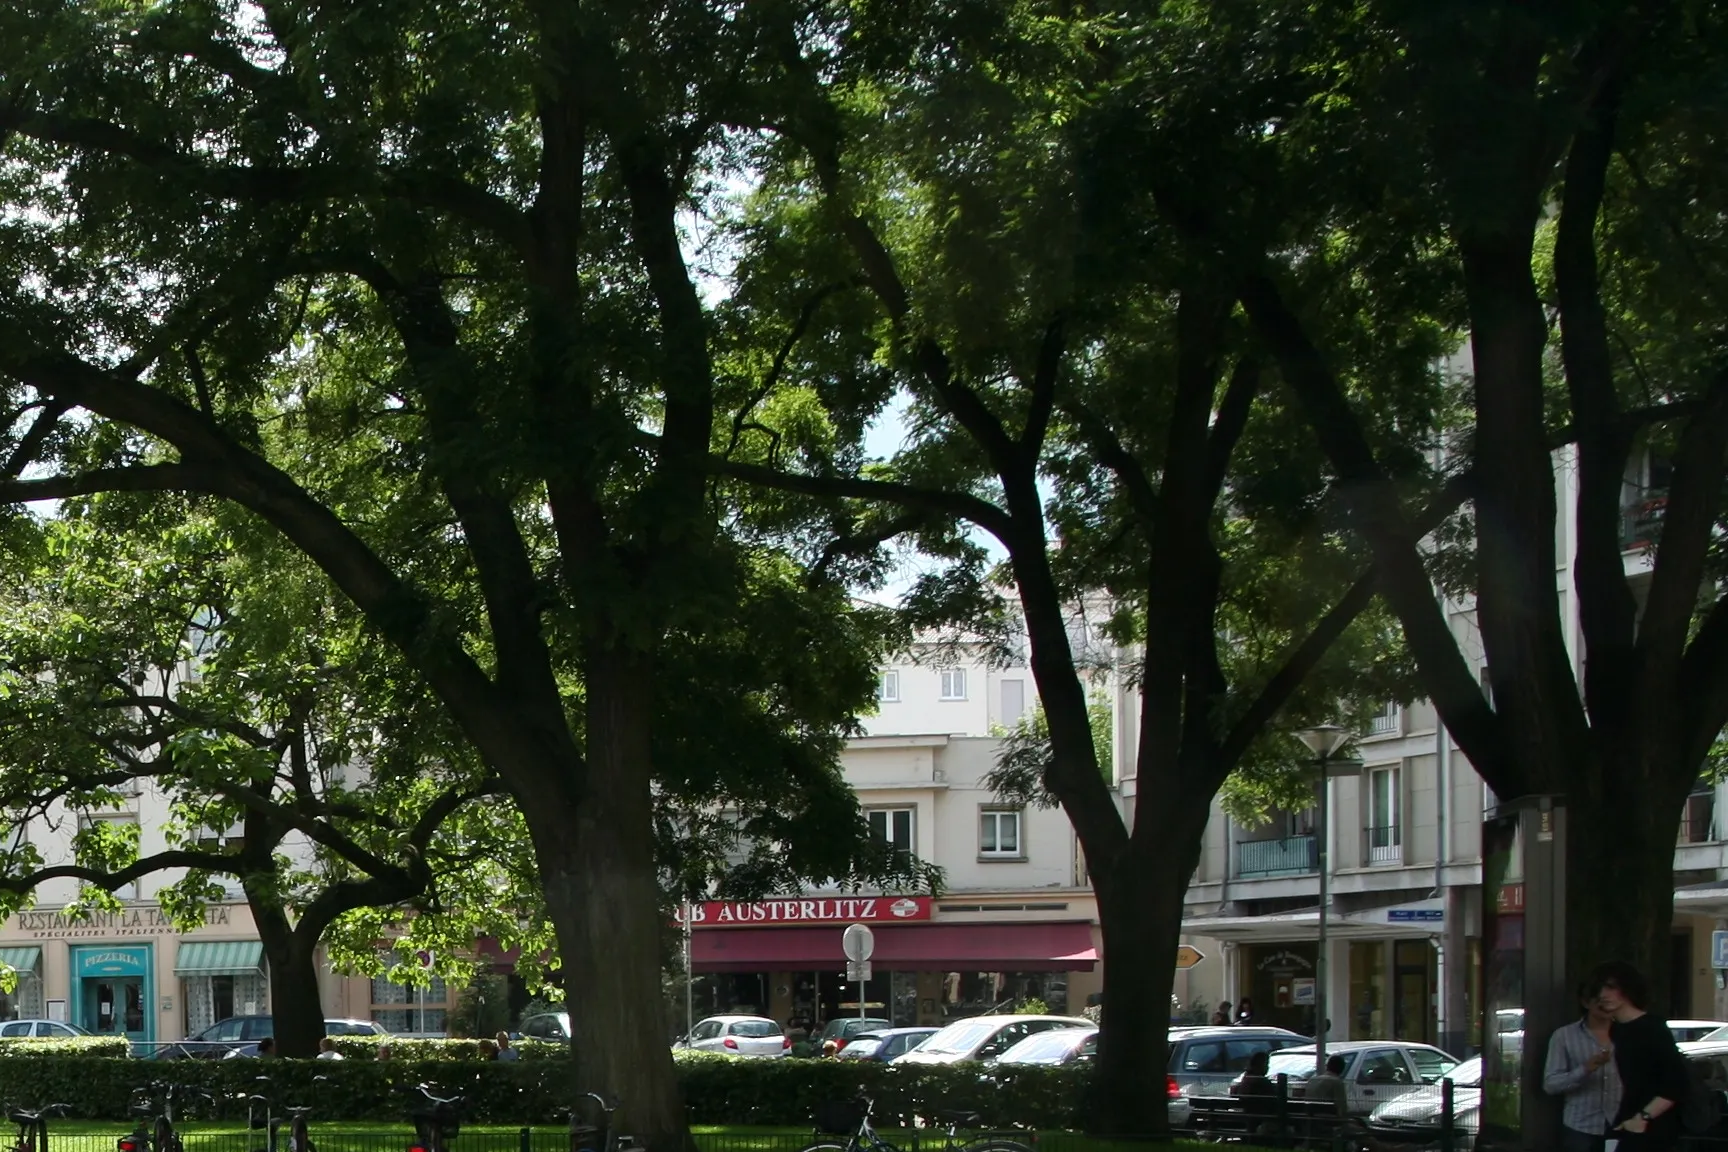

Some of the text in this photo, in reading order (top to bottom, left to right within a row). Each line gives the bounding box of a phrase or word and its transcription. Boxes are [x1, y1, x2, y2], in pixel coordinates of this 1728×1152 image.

[122, 908, 142, 928] LA
[673, 899, 876, 923] UB AUSTERLITZ
[33, 928, 181, 938] SPECIALITES ITALIENNE
[85, 951, 139, 967] PIZZERIA
